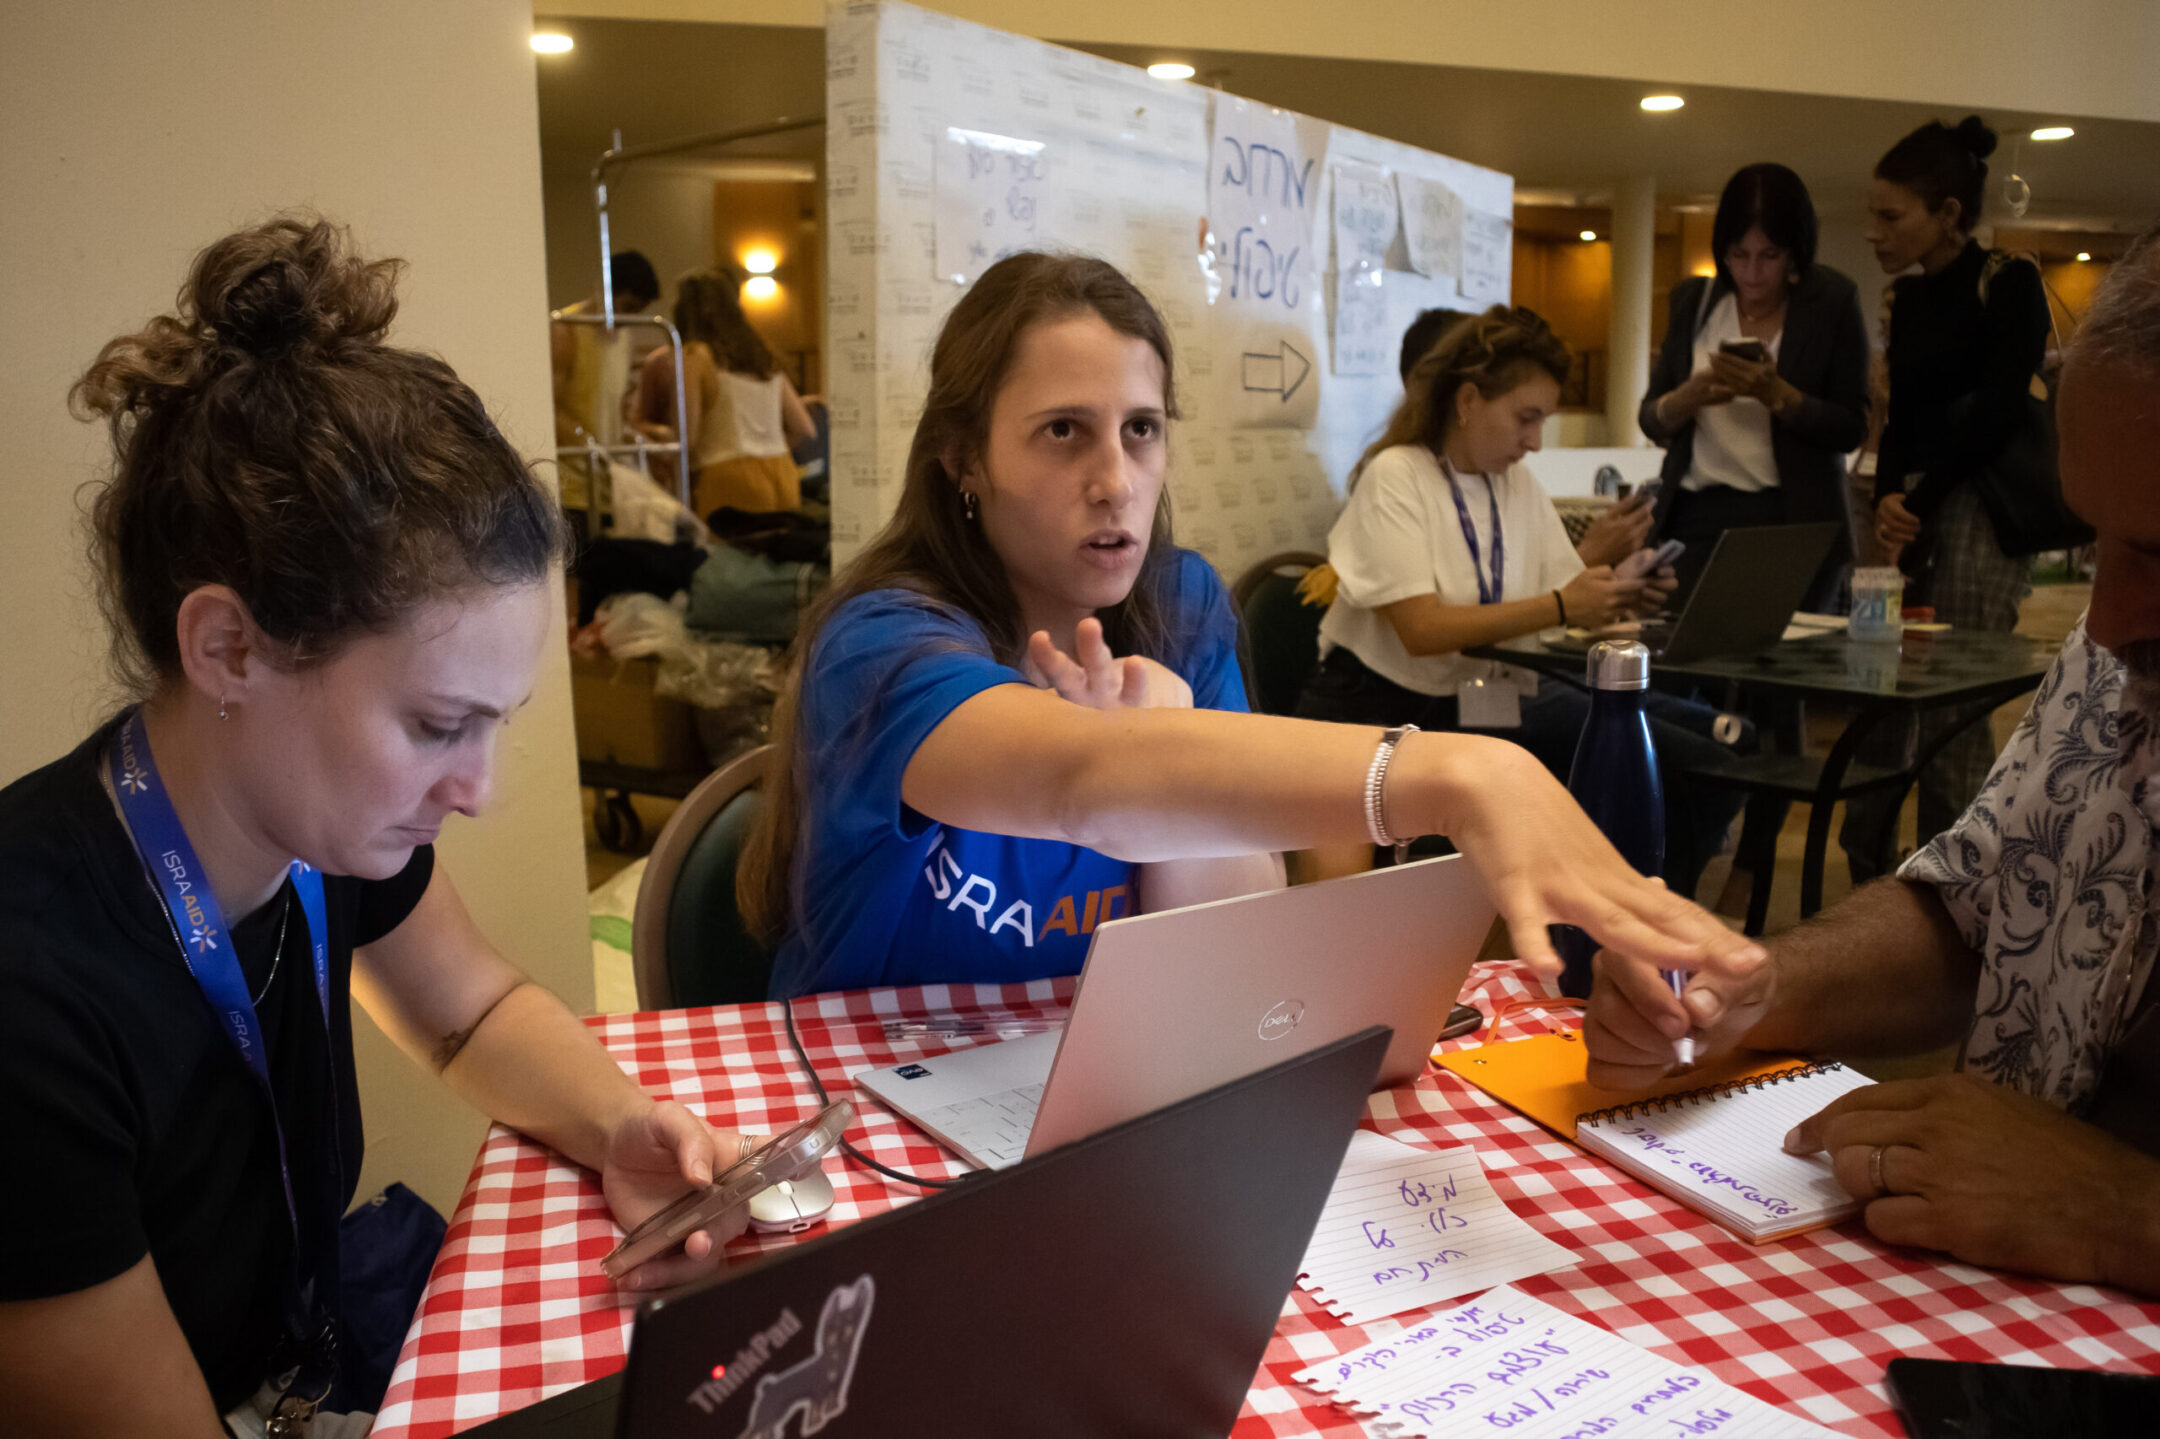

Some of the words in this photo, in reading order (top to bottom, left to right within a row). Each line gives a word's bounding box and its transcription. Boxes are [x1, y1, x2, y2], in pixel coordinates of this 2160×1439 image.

[161, 850, 204, 927] ISRAAID
[1398, 1173, 1457, 1207] מידע
[1362, 1221, 1395, 1249] על
[1421, 1207, 1468, 1234] כללי
[686, 1306, 803, 1414] ThinkPad
